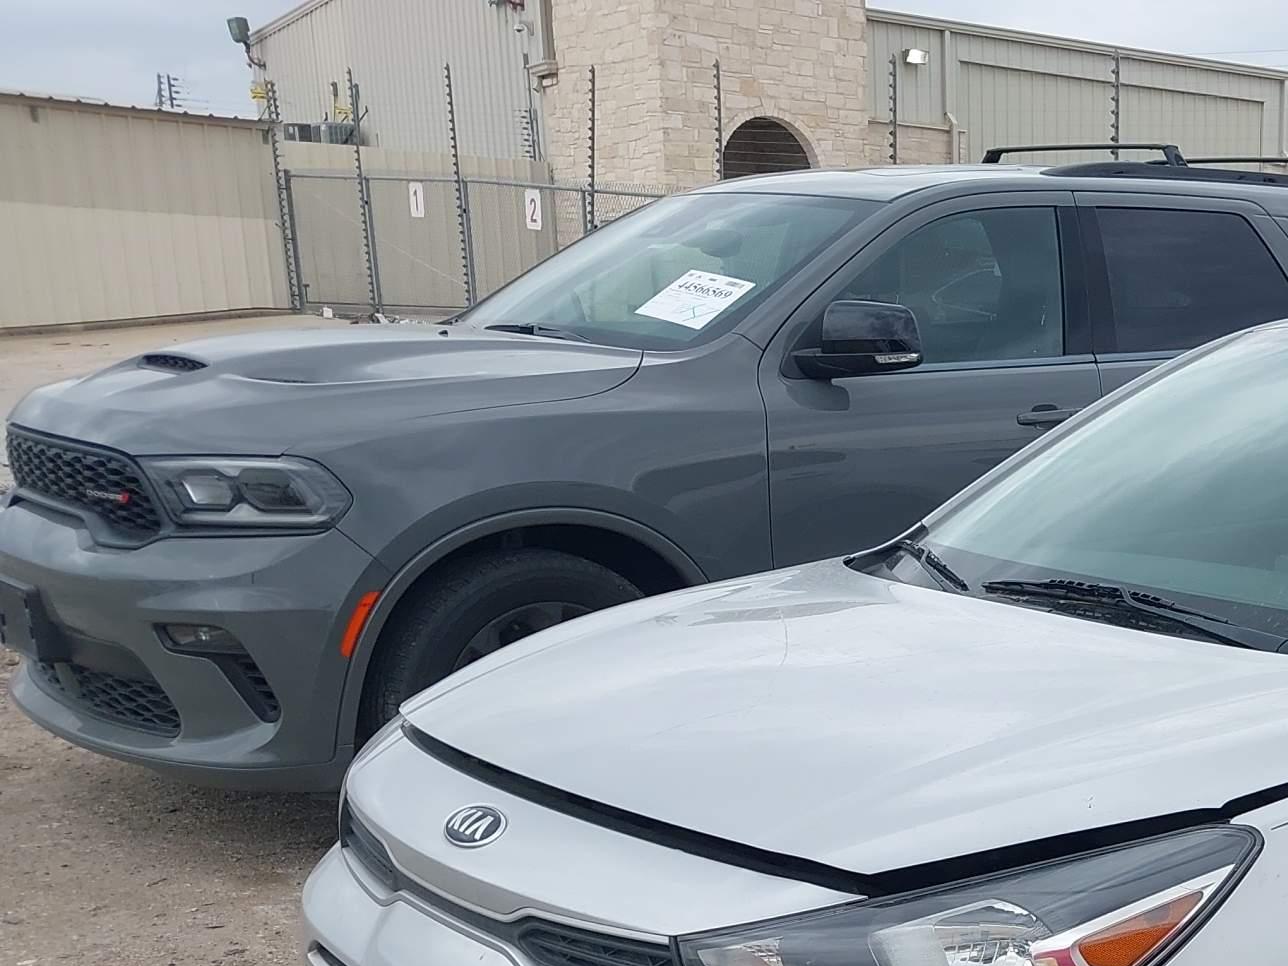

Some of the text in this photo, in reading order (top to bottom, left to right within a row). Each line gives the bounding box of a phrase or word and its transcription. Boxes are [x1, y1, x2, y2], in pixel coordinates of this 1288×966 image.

[412, 188, 420, 213] 1
[529, 197, 538, 224] 2
[447, 808, 496, 841] KIA
